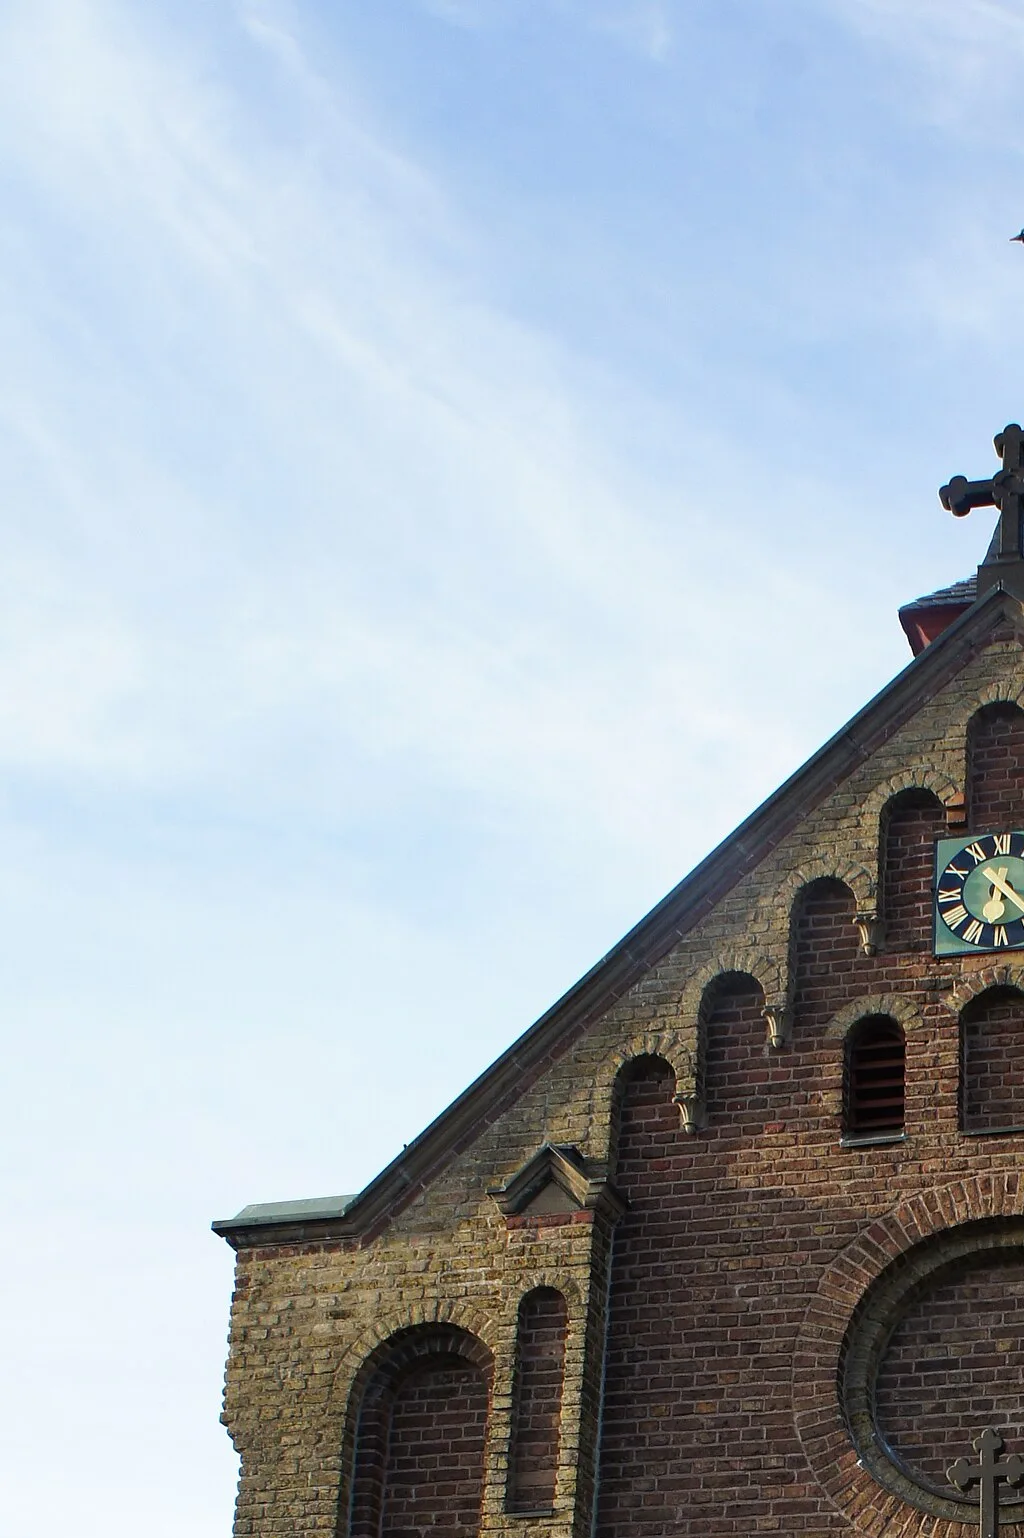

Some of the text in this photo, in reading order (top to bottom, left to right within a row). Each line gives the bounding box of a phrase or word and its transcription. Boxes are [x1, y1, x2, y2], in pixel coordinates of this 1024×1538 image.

[965, 842, 987, 865] XI
[993, 834, 1011, 856] XII
[945, 863, 969, 880] X
[938, 888, 961, 903] IX
[942, 905, 969, 931] VIII
[962, 919, 984, 945] VII
[994, 926, 1008, 947] VI
